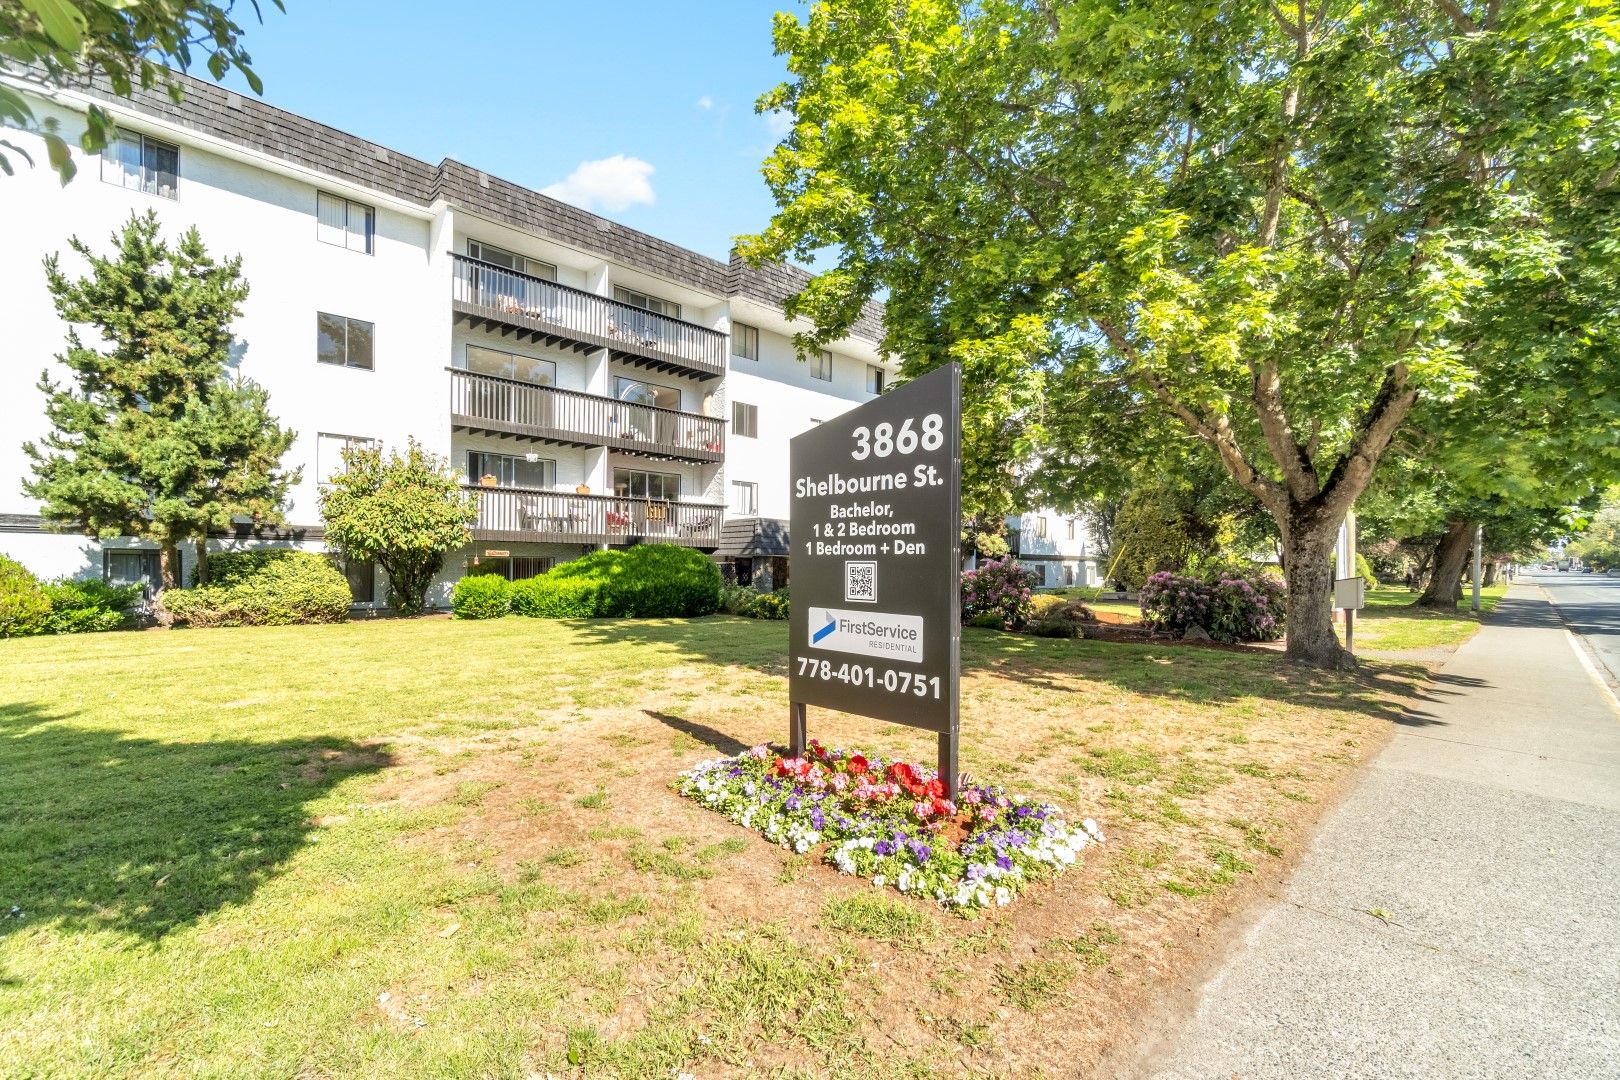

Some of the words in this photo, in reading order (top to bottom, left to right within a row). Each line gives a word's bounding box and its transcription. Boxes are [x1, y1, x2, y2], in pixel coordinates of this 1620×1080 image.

[851, 413, 944, 461] 3868
[795, 472, 908, 498] Shelbourne
[913, 464, 944, 488] St.
[830, 501, 894, 519] Bachelor,
[813, 523, 820, 537] 1
[824, 522, 834, 537] &
[837, 522, 846, 537] 2
[849, 520, 916, 536] Bedroom
[805, 542, 812, 555] 1
[816, 540, 876, 556] Bedroom
[880, 543, 890, 554] +
[894, 540, 925, 555] Den
[839, 619, 917, 641] FirstService
[868, 640, 917, 654] RESIDENTIAL
[797, 656, 940, 699] 778-401-0751
